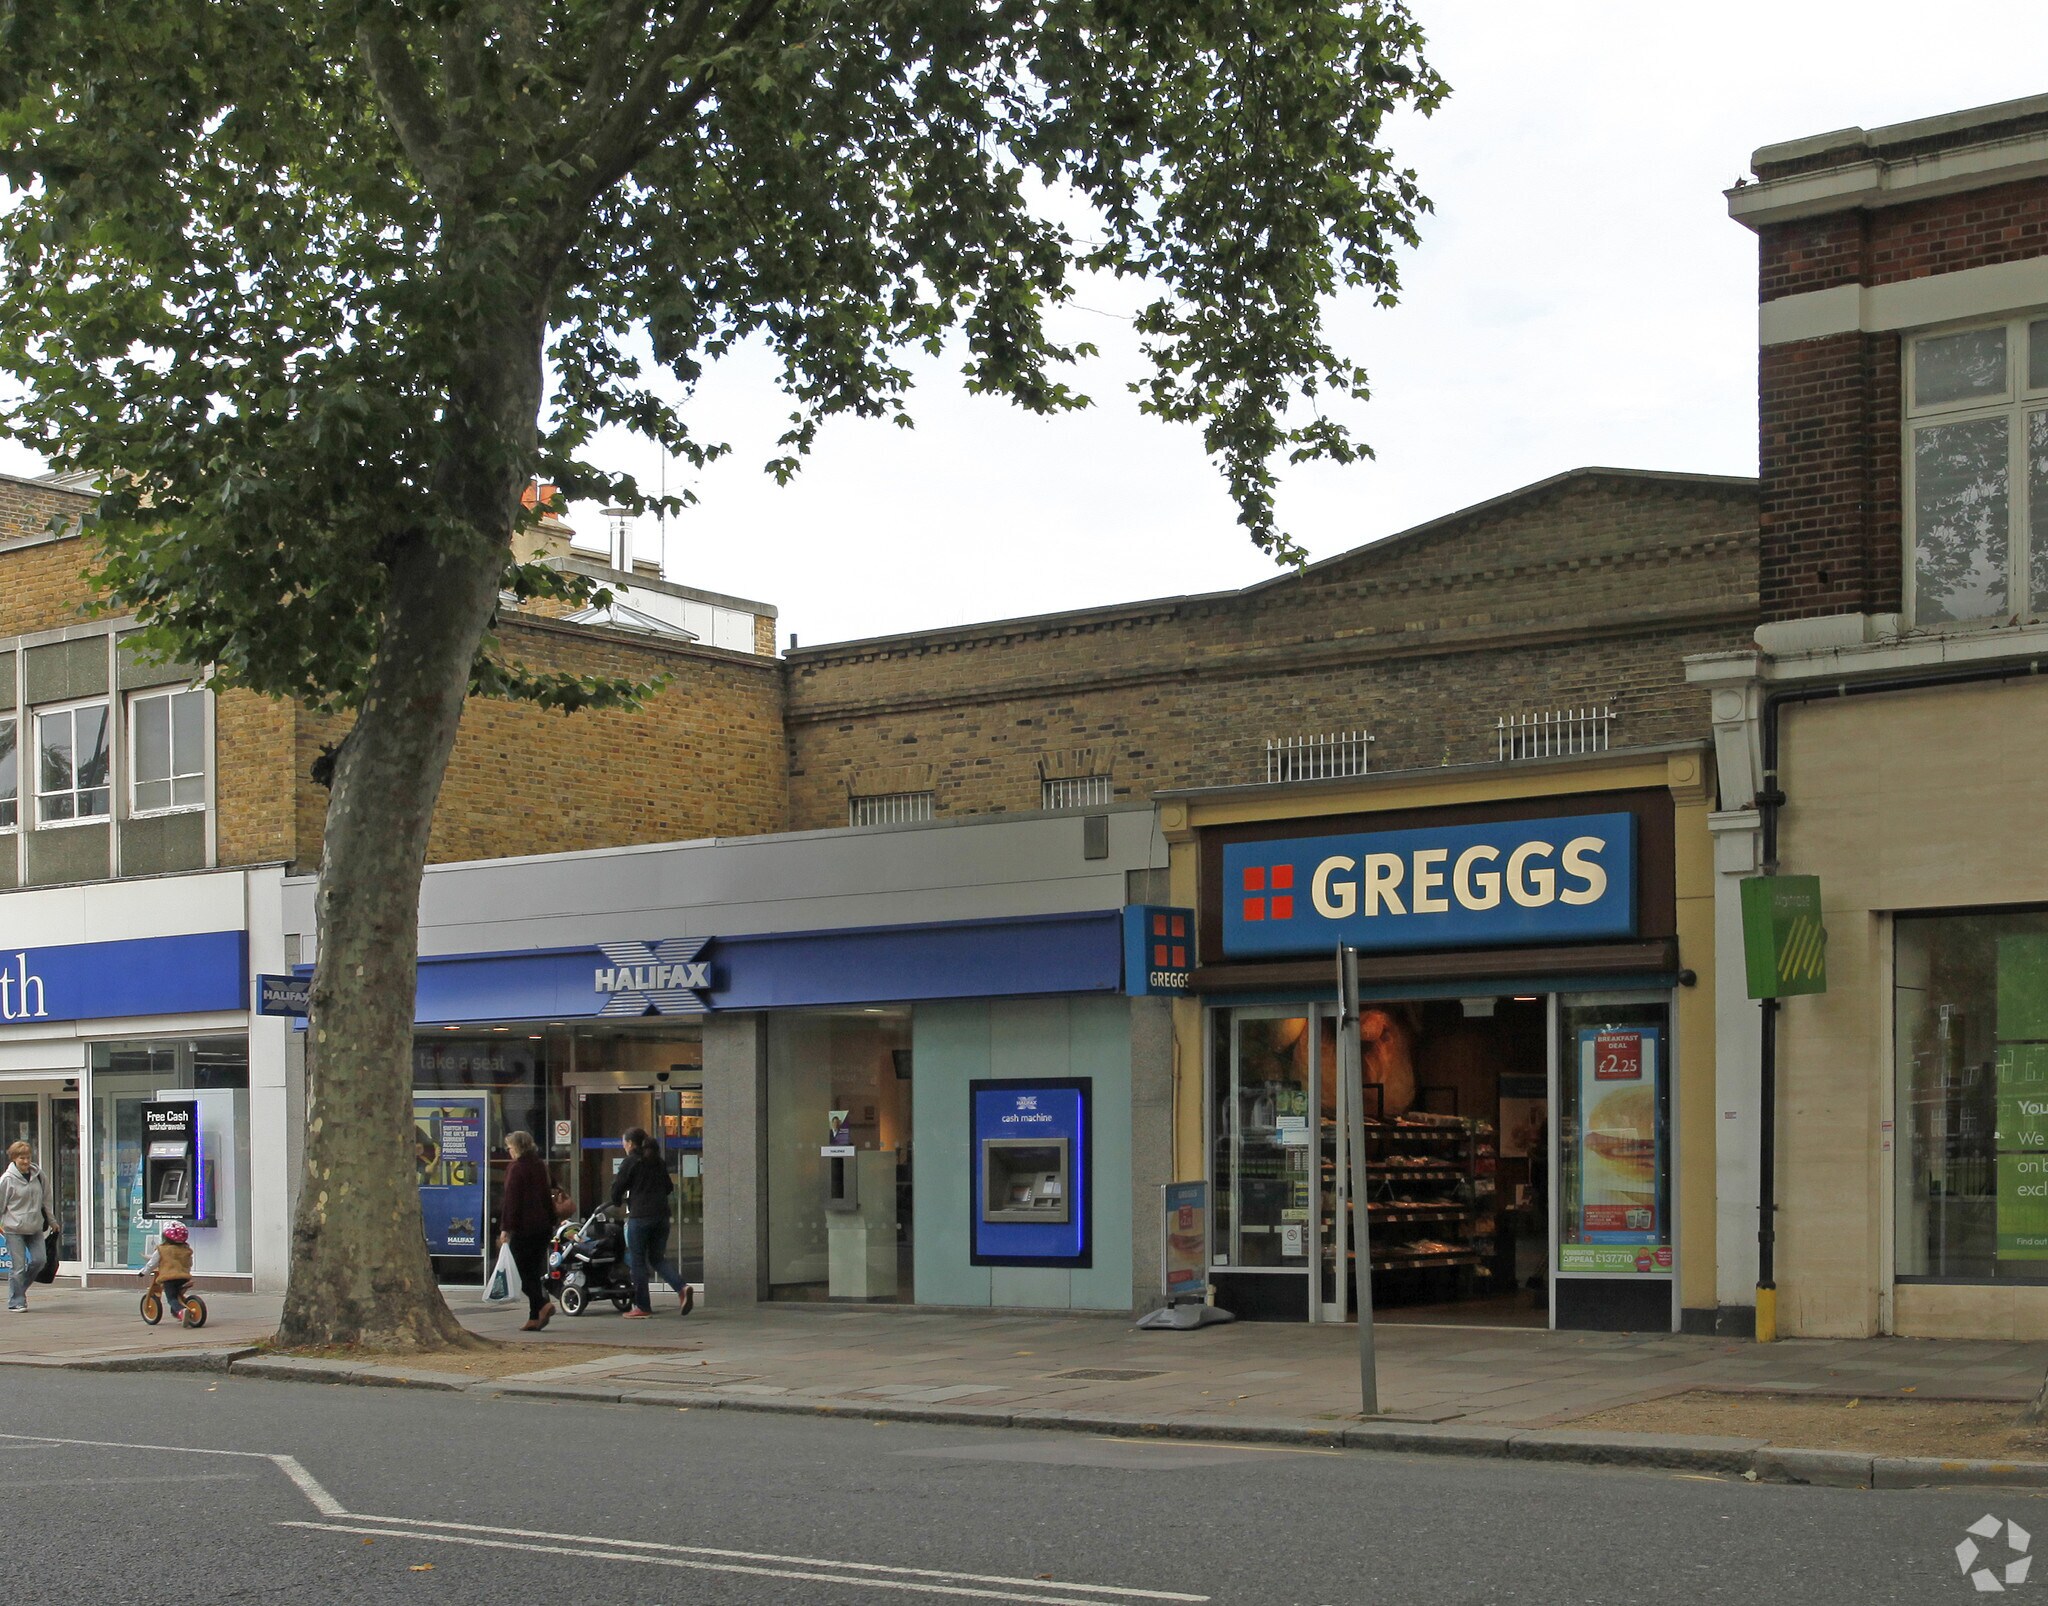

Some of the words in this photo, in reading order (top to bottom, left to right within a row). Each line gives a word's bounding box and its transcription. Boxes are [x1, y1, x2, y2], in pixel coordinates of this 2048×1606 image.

[1311, 836, 1608, 920] GREGGS
[595, 962, 709, 992] HALIFAX
[0, 952, 49, 1019] th
[1597, 1035, 1639, 1043] BREAKFAST
[420, 1051, 455, 1070] take
[460, 1056, 469, 1070] a
[473, 1055, 505, 1071] seat
[1599, 1054, 1638, 1073] £2.25
[146, 1110, 165, 1122] Free
[166, 1110, 189, 1122] Cash
[1001, 1114, 1019, 1123] cash
[1020, 1113, 1053, 1122] machine
[148, 1122, 186, 1131] withdrawals
[2017, 1131, 2045, 1146] We
[2017, 1162, 2039, 1173] on
[2016, 1237, 2033, 1246] Find
[2033, 1237, 2048, 1246] out
[1595, 1254, 1634, 1264] £137,710
